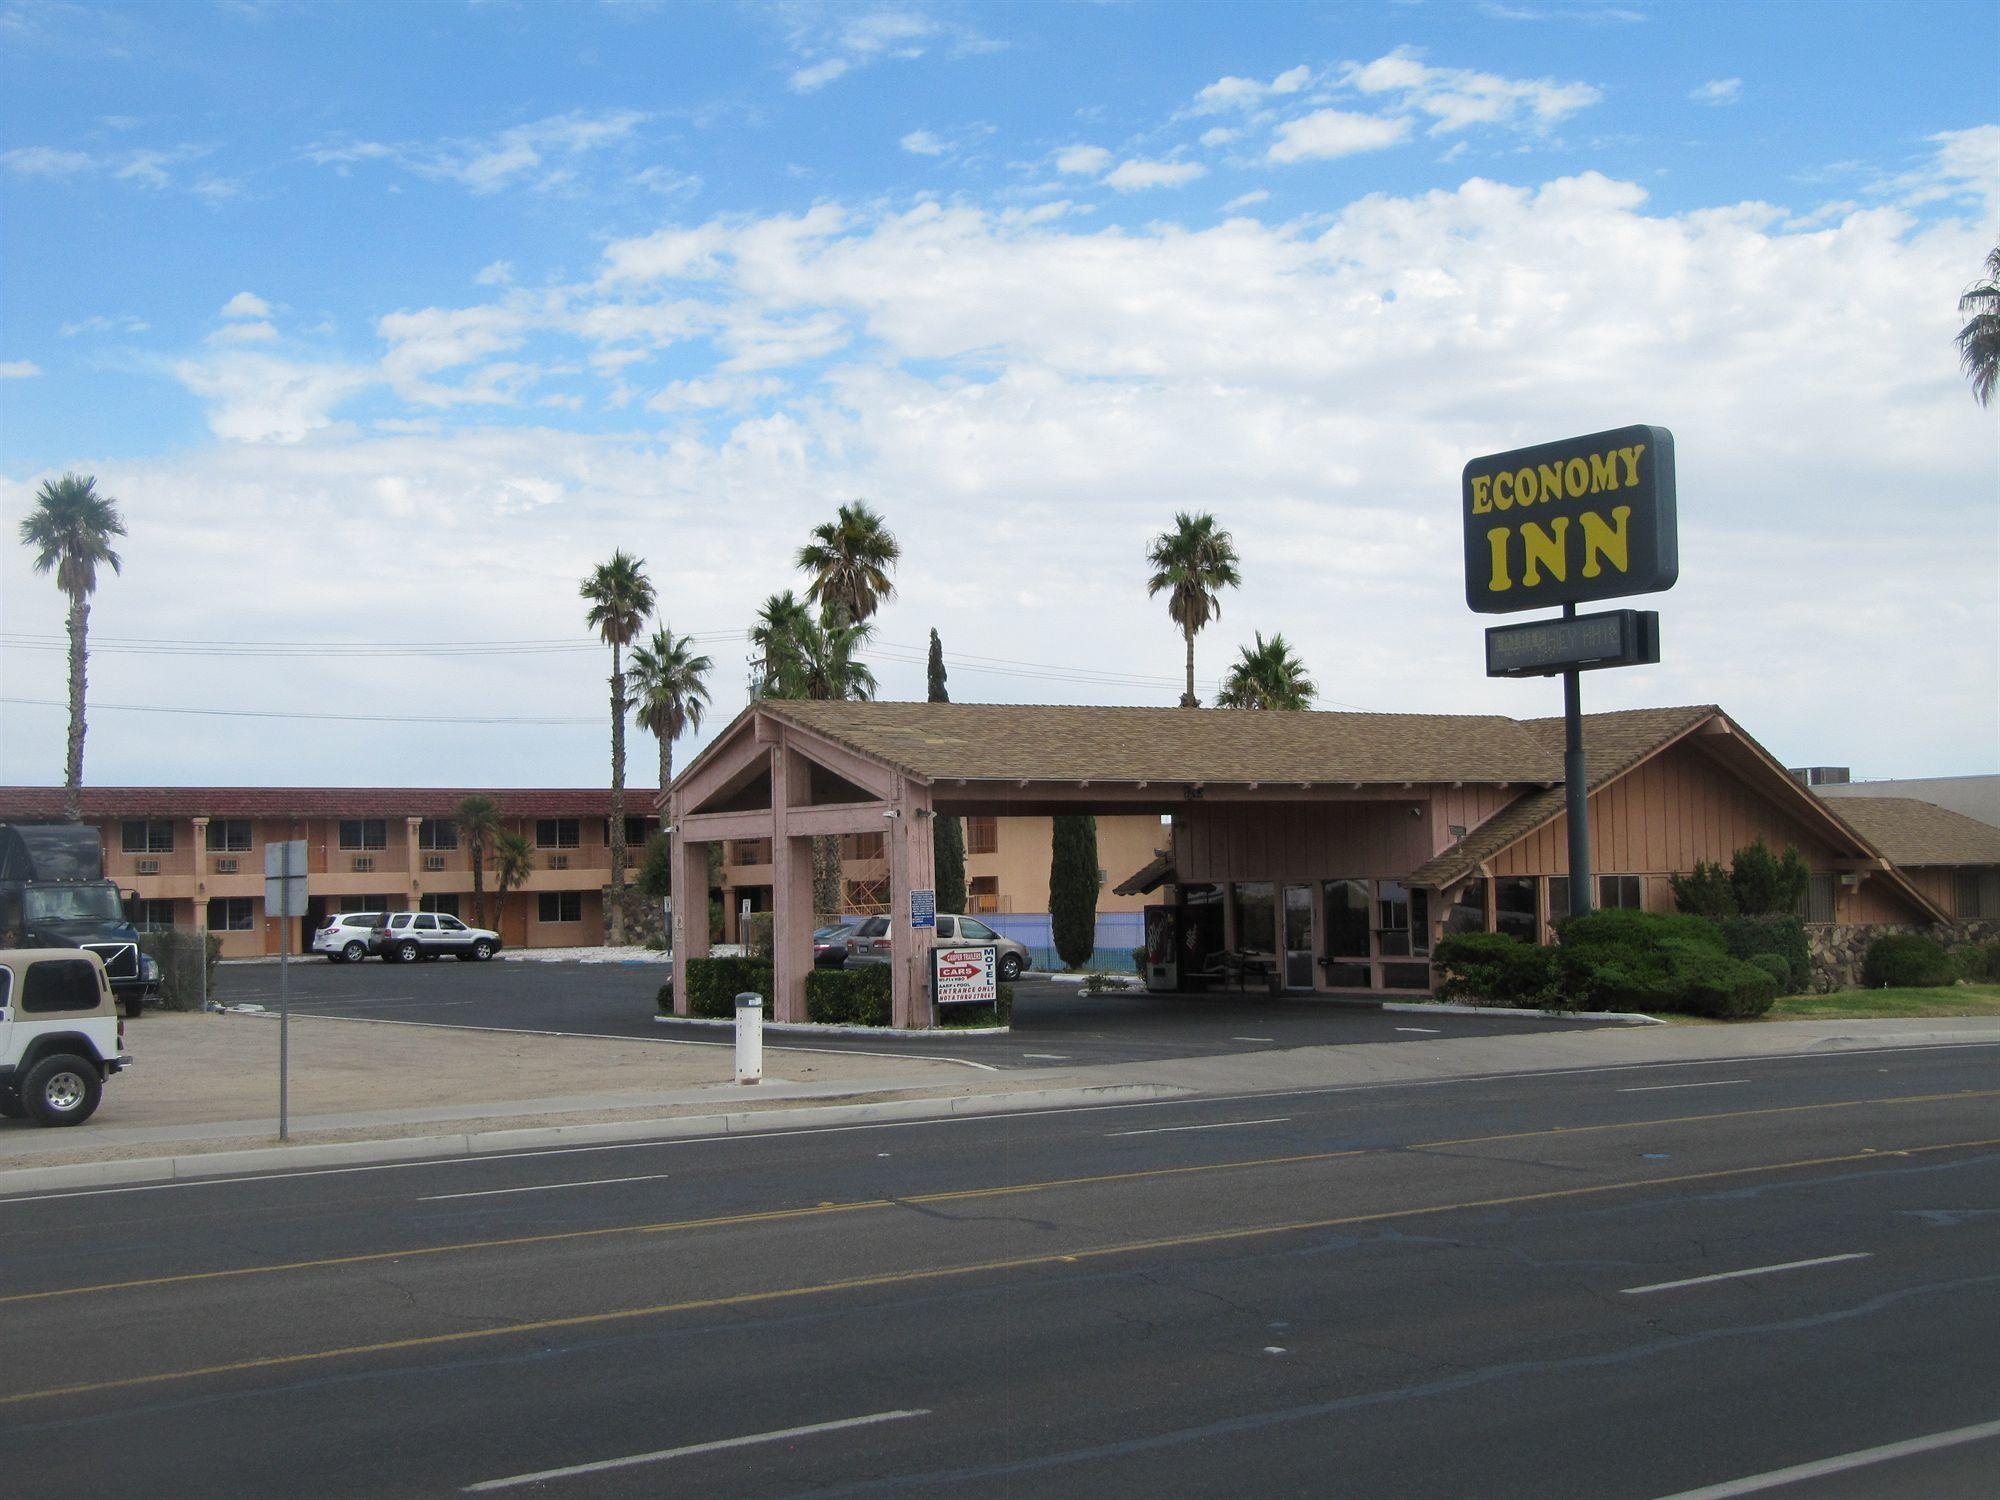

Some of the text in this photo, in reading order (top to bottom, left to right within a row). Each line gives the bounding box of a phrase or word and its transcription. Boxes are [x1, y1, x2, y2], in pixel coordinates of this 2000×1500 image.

[1471, 444, 1645, 515] ECONOMY
[1487, 505, 1631, 592] INN
[943, 968, 972, 976] CARS
[963, 952, 981, 961] TRAILERS
[984, 949, 993, 985] MOTEL
